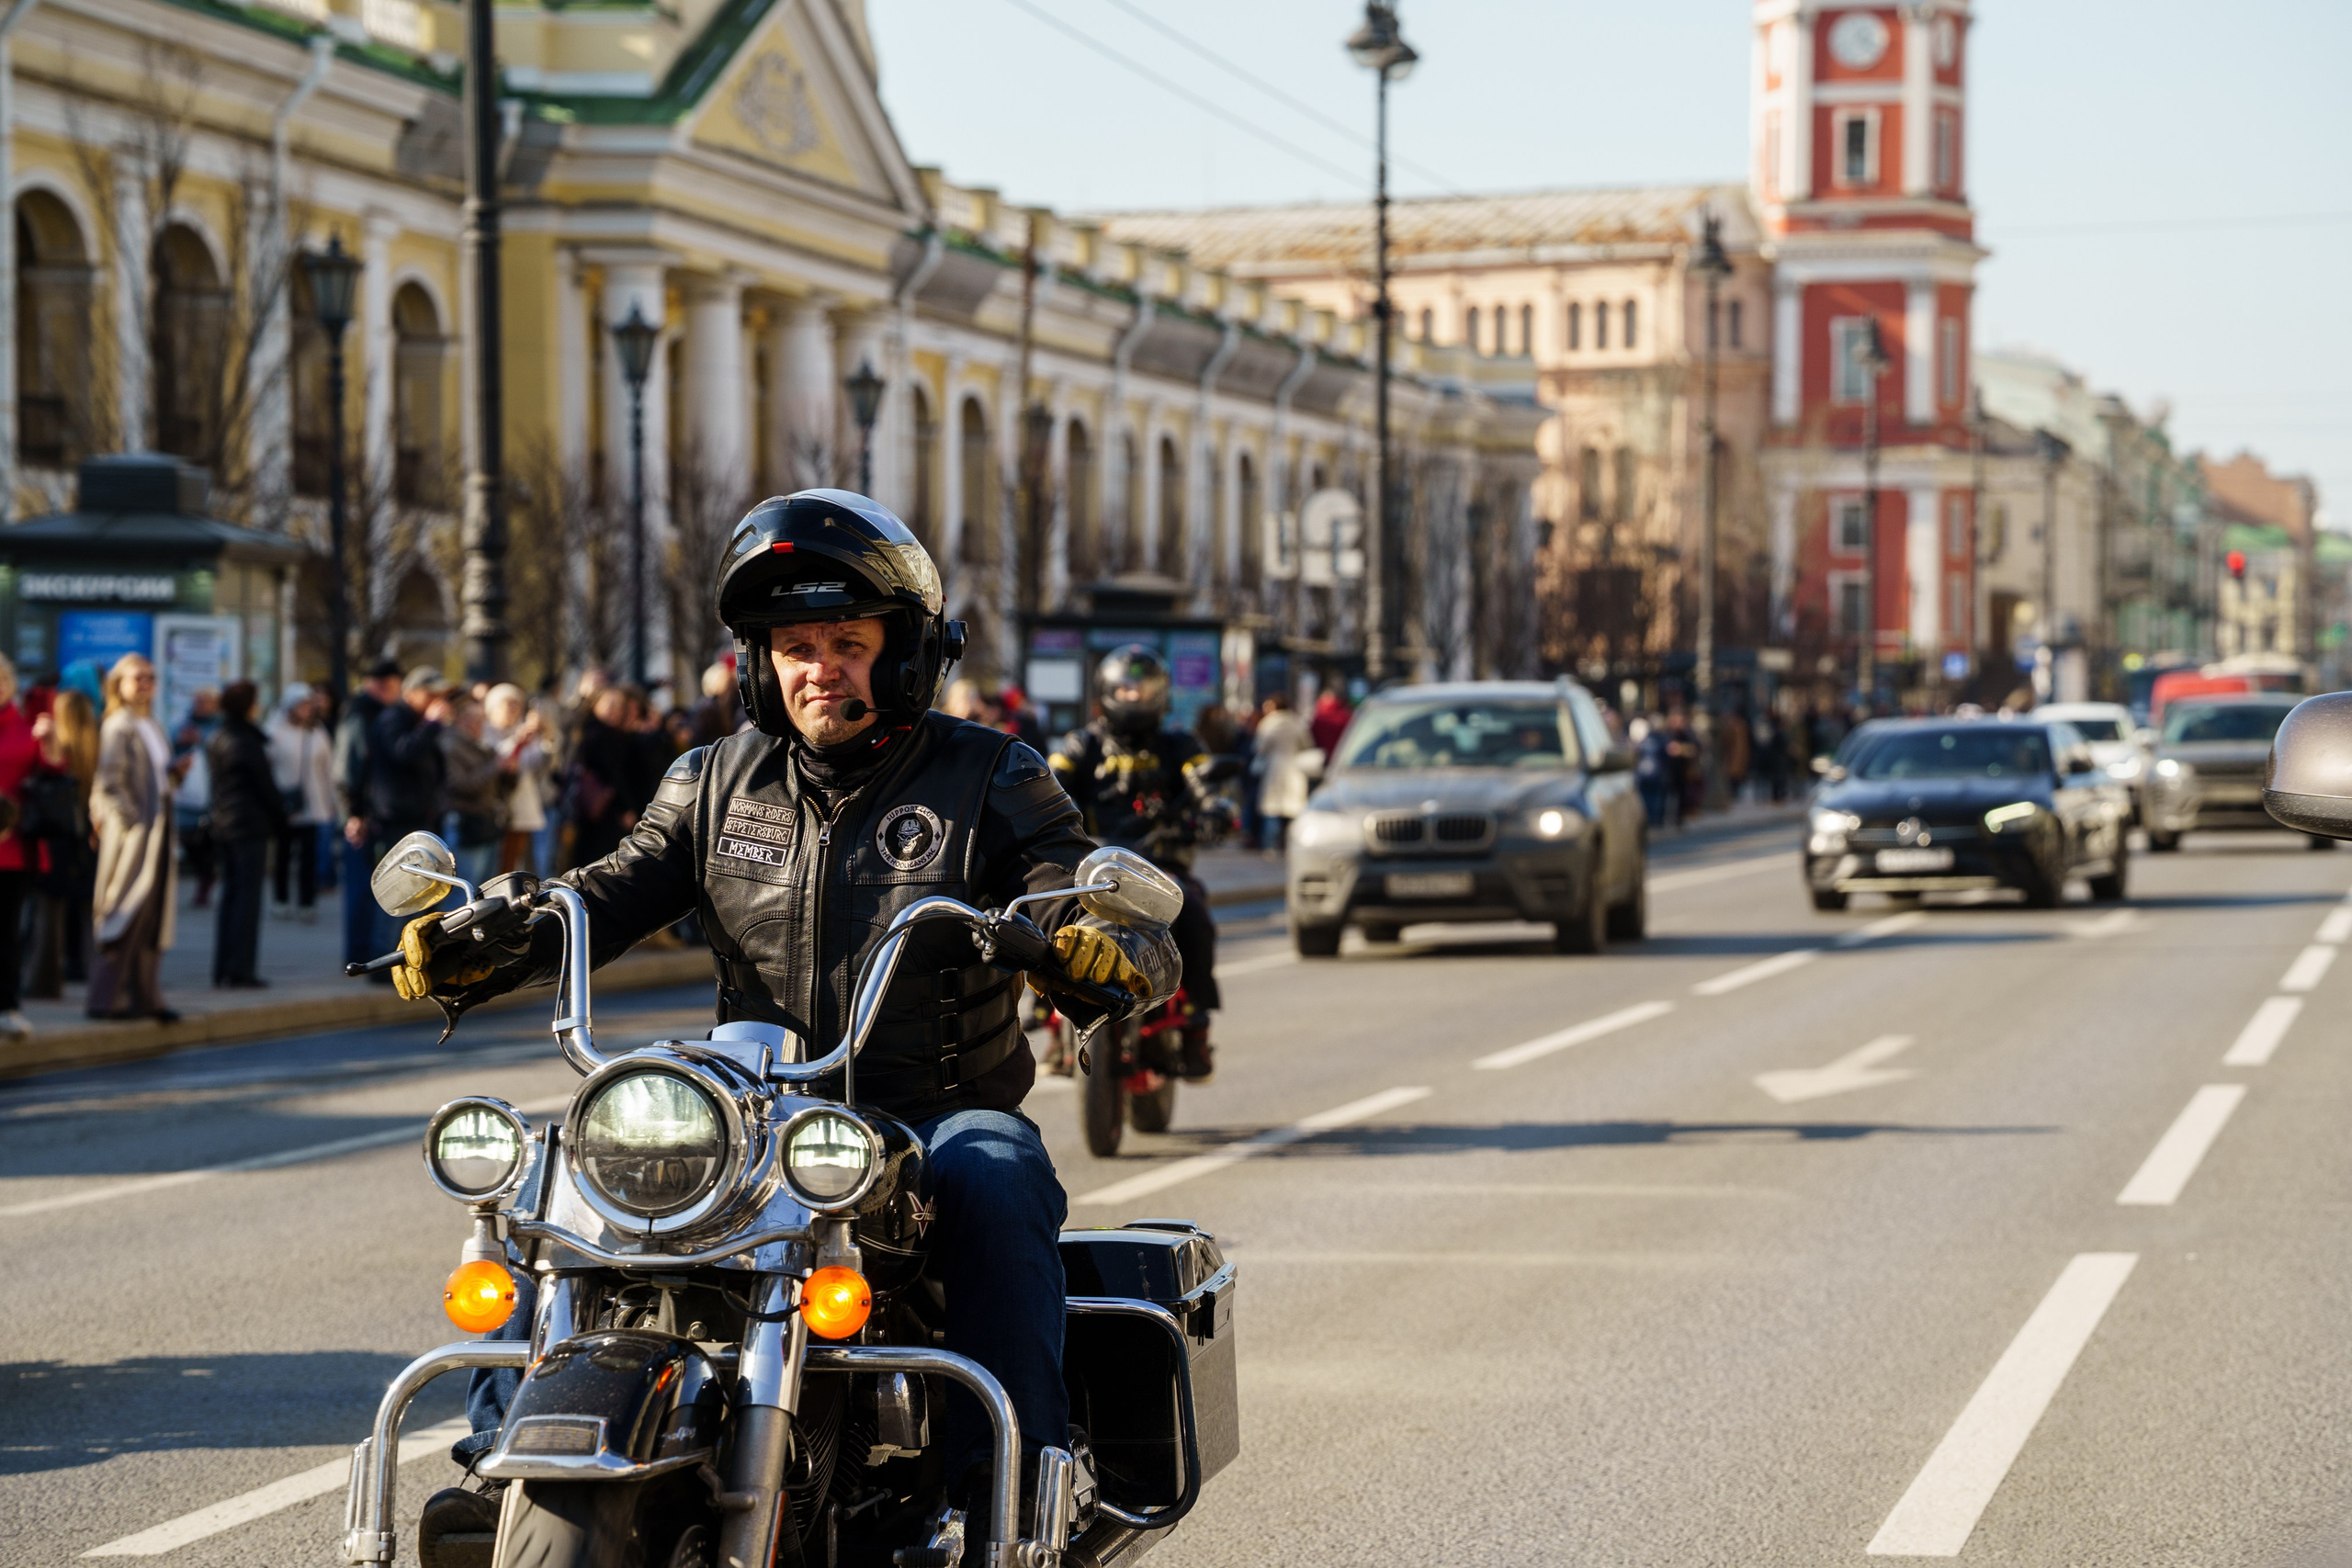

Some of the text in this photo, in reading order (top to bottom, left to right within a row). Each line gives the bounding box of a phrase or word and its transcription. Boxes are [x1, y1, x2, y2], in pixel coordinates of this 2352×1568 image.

[20, 572, 175, 598] ЭКСКУРСИИ
[771, 581, 847, 597] LS2
[731, 800, 792, 822] NORMANS RIDERS
[886, 806, 935, 822] SUPPORT CLUB
[729, 840, 774, 863] MEMBER
[881, 848, 935, 868] THE HOOLIGANS MC
